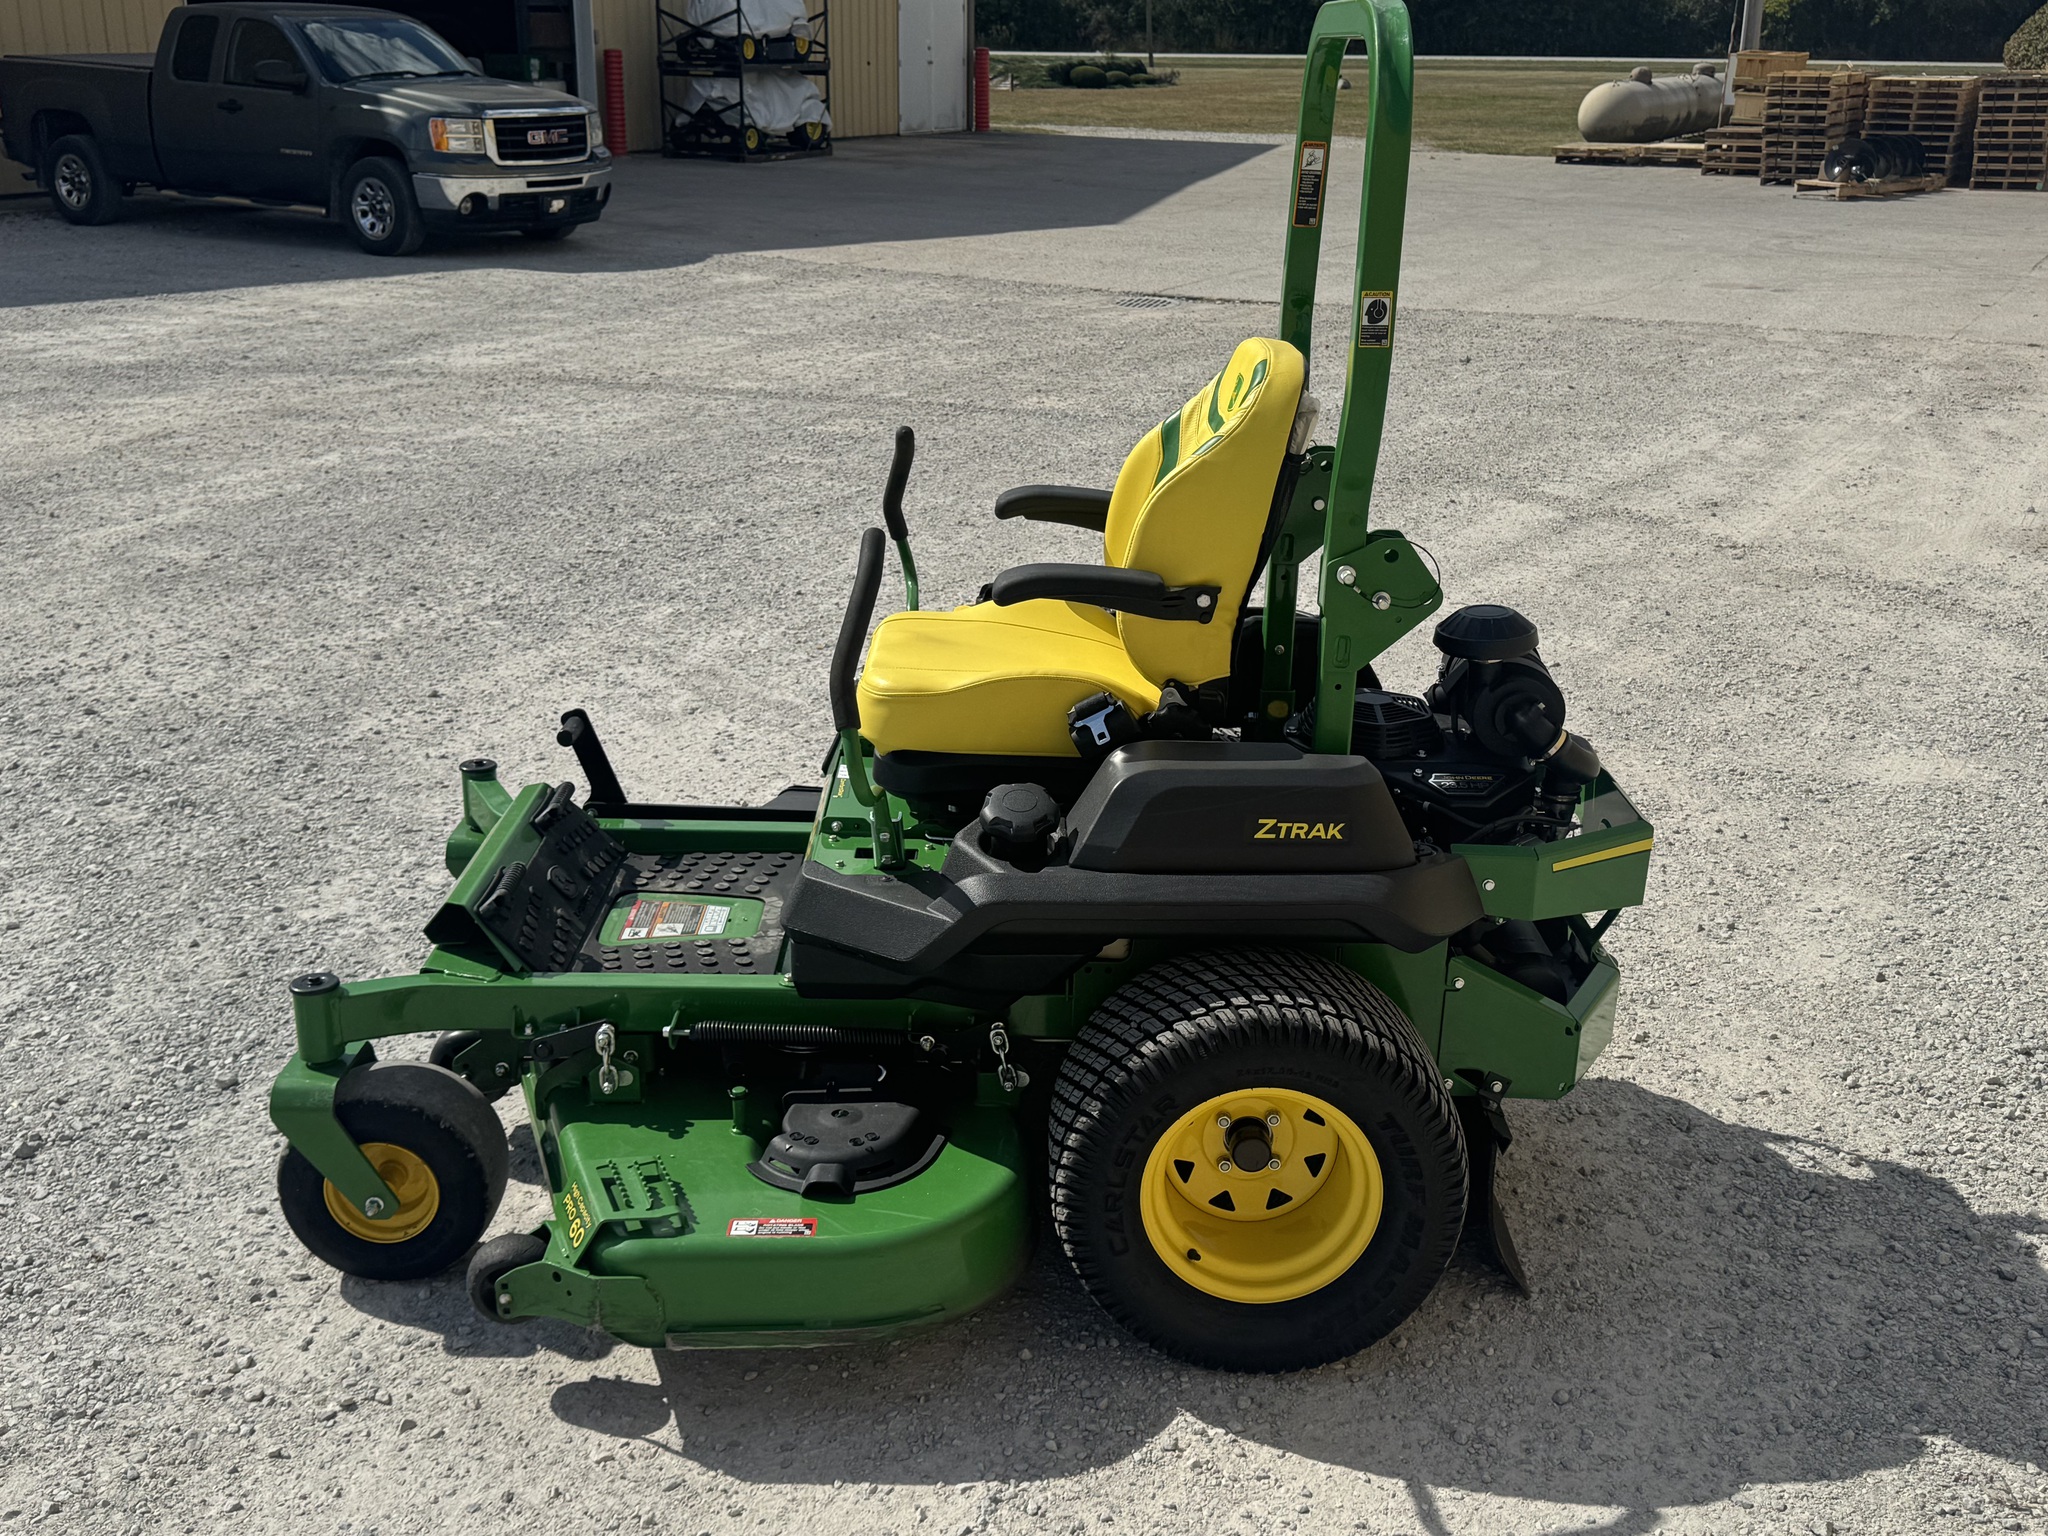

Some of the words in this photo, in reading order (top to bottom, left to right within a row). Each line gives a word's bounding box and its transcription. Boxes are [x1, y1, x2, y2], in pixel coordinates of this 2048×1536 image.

[527, 128, 569, 145] GMC
[1440, 781, 1468, 789] 23.5
[1253, 818, 1346, 840] ZTRAK
[1376, 1111, 1427, 1208] TURF
[1105, 1094, 1181, 1258] CARLSTAR
[562, 1193, 577, 1221] PRO
[569, 1217, 585, 1249] 60
